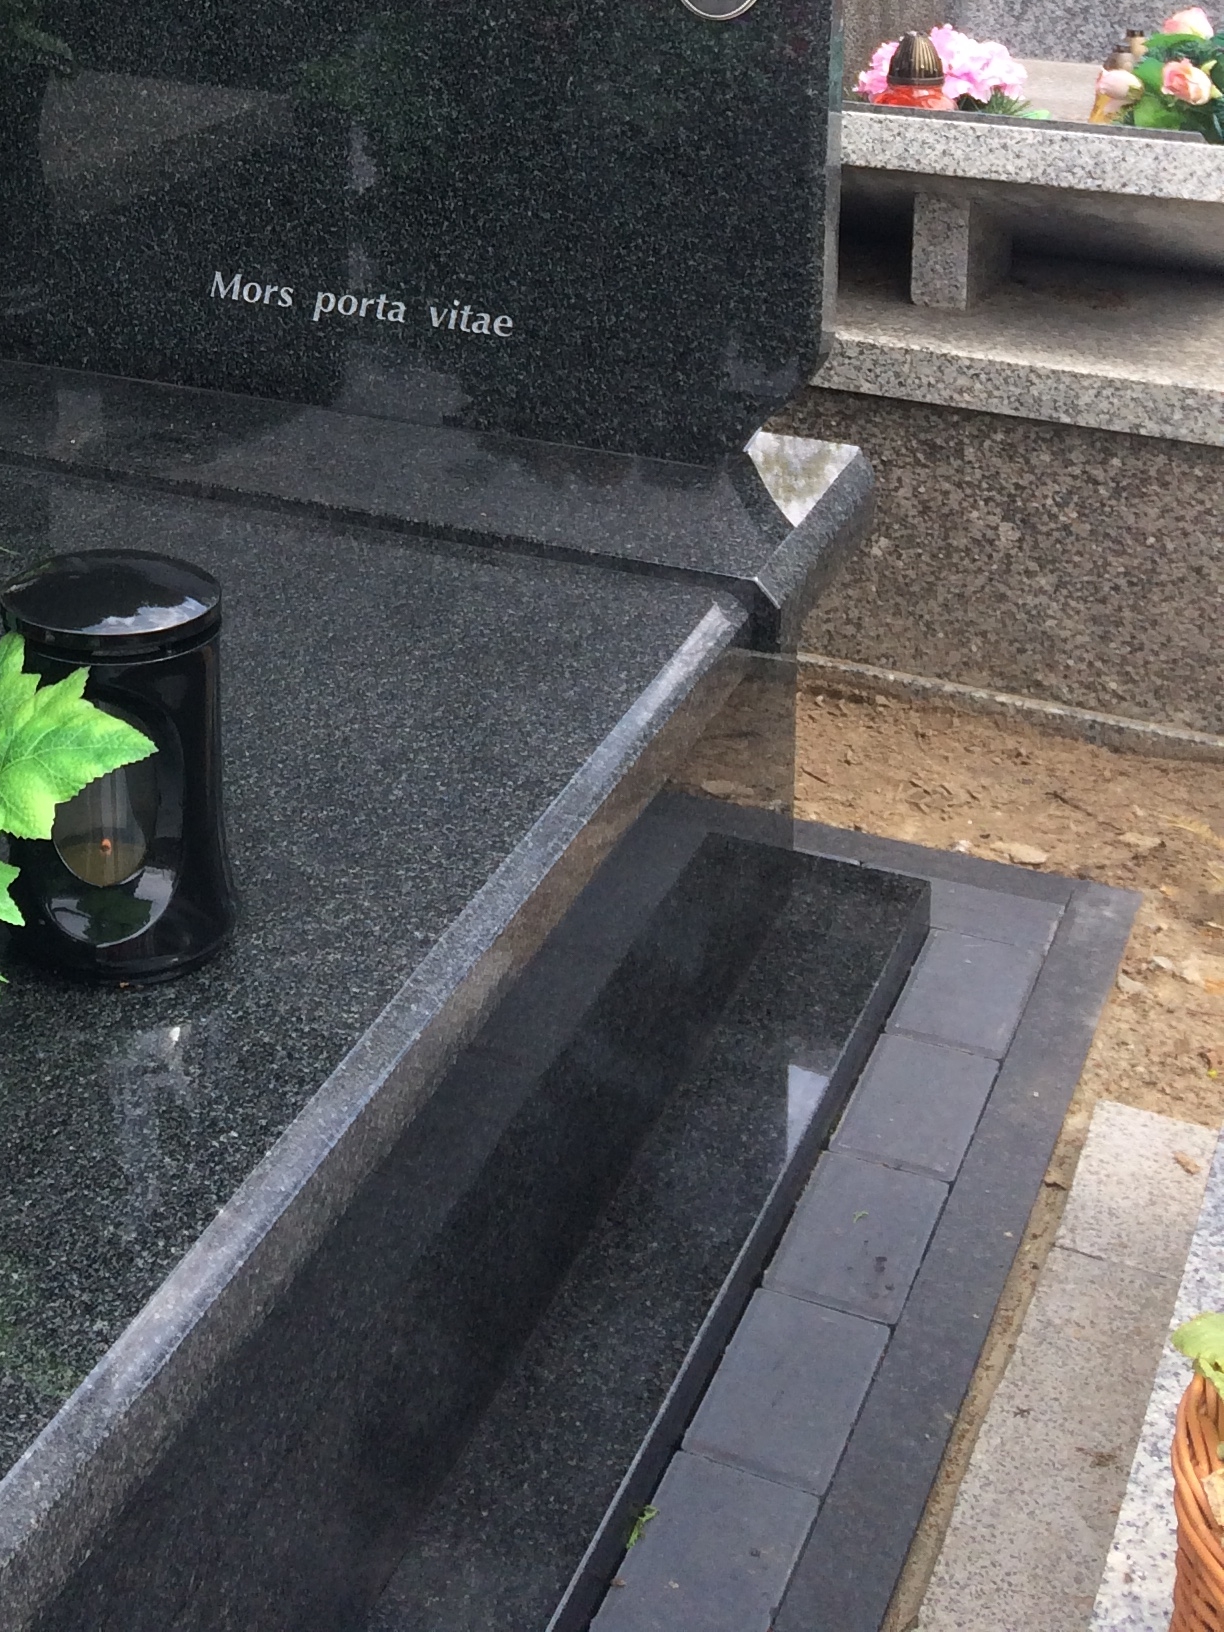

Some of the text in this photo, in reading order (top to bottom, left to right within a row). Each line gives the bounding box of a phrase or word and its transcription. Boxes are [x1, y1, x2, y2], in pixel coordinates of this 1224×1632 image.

[209, 270, 514, 338] Mors porta vitae
